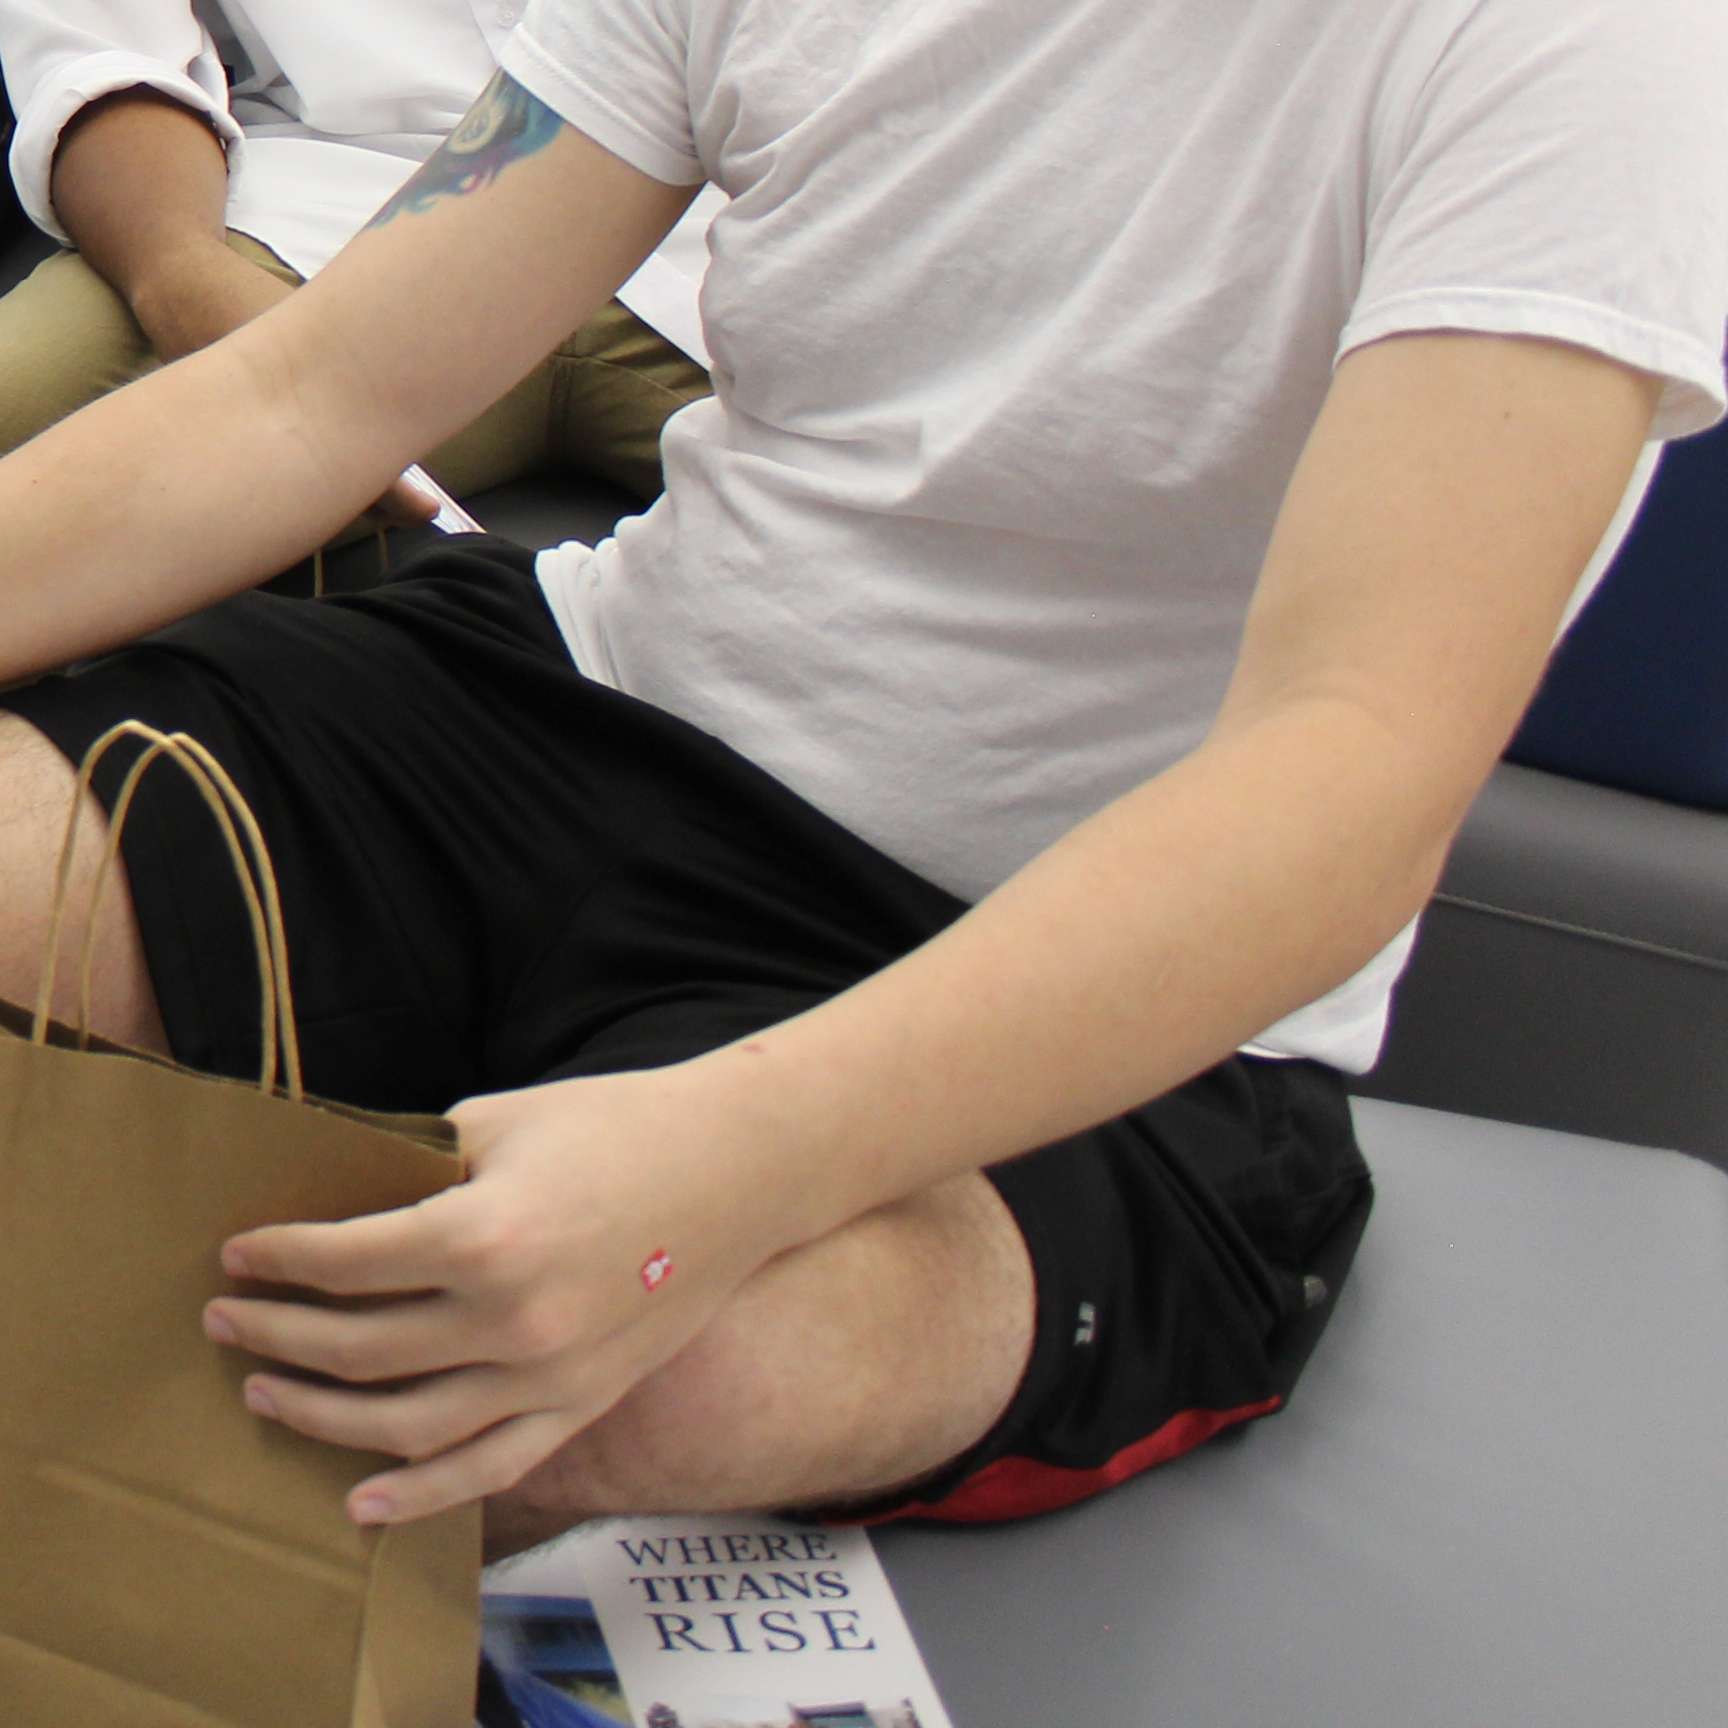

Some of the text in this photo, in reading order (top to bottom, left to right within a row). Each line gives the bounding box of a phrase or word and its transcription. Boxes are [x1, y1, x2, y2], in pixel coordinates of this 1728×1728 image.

[615, 1532, 838, 1566] WHERE
[629, 1570, 850, 1603] TITANS
[648, 1609, 877, 1653] RISE
